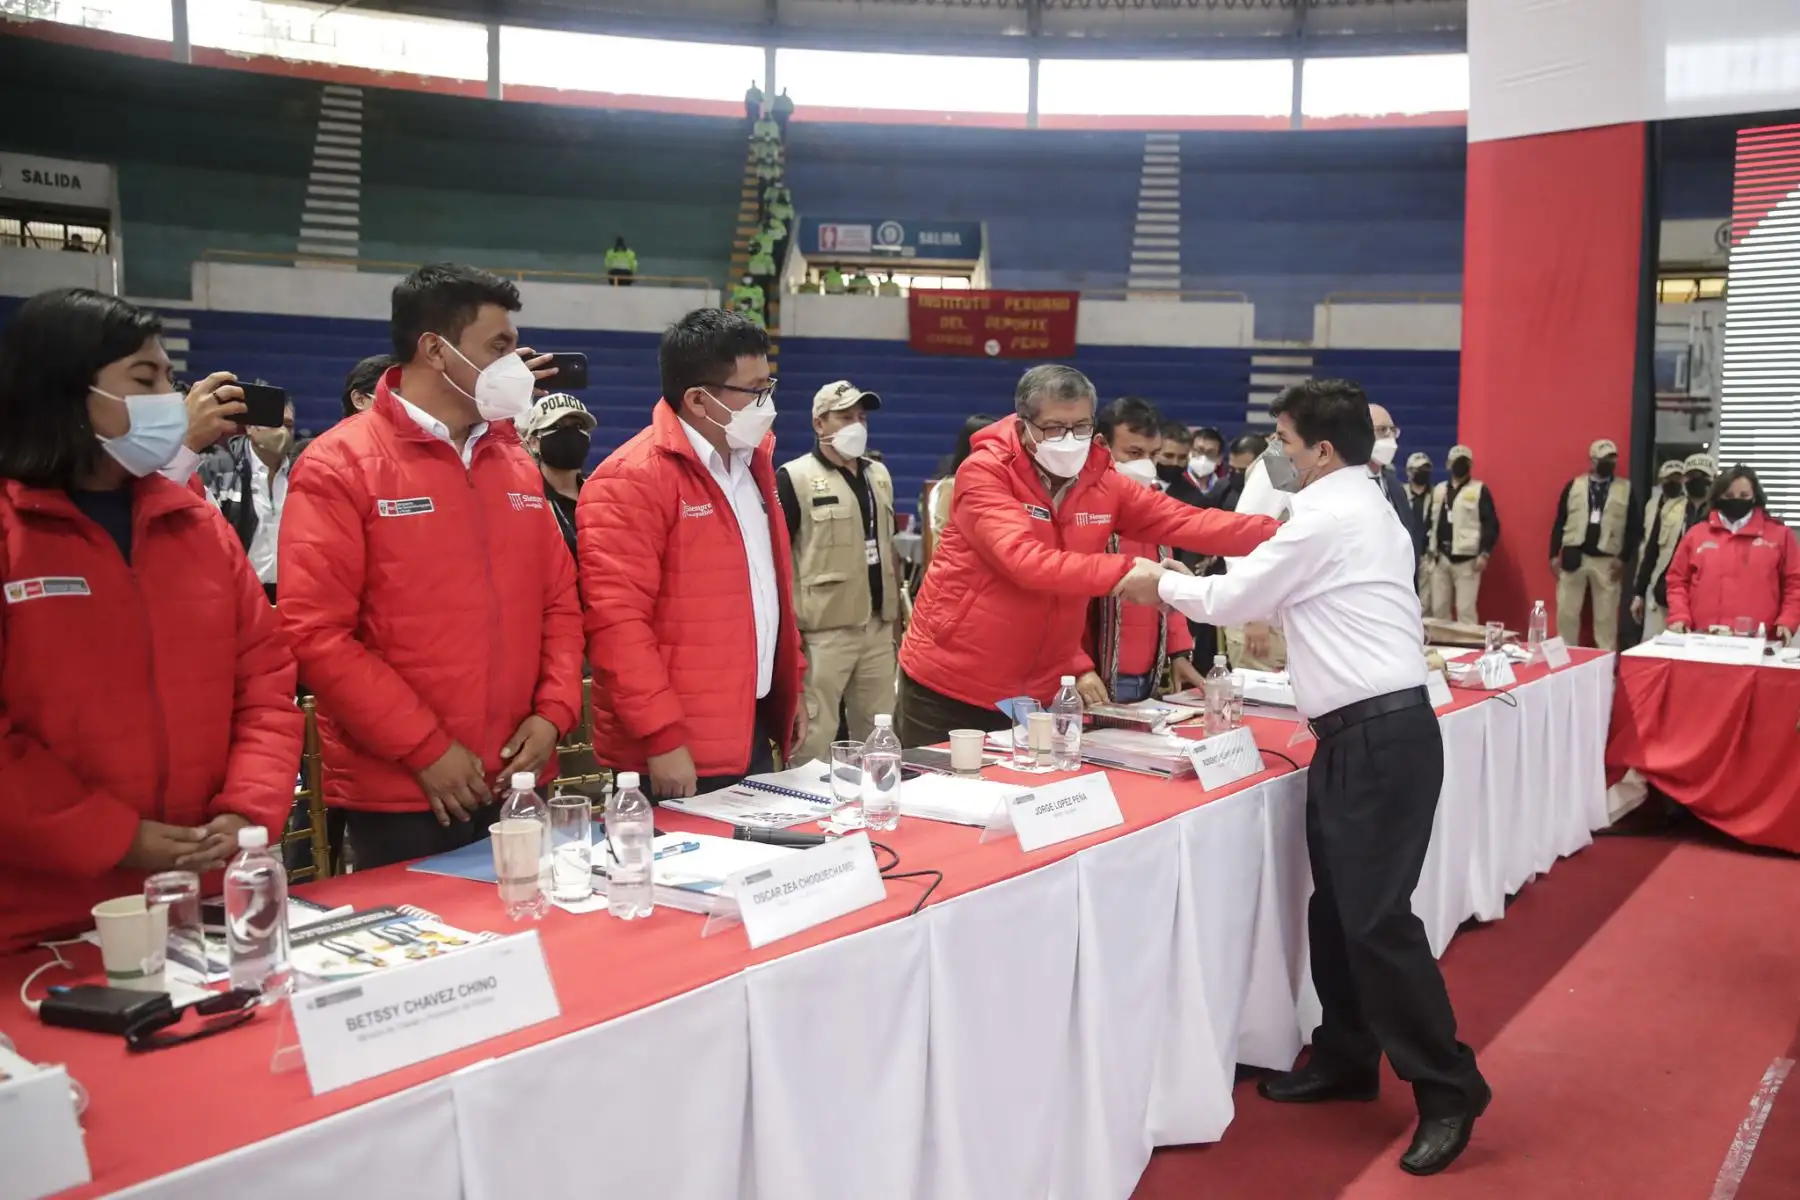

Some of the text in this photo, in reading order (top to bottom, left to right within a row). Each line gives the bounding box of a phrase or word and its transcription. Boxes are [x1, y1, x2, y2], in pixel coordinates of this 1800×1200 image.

[21, 168, 82, 190] SALIDA
[918, 231, 962, 246] SALIDA
[939, 315, 968, 330] DEL
[1035, 802, 1054, 815] JORGE
[753, 886, 783, 905] OSCAR
[782, 880, 798, 896] ZEA
[345, 1003, 400, 1032] BETSSY
[403, 987, 456, 1015] CHAVEZ
[457, 976, 498, 999] CHINO
